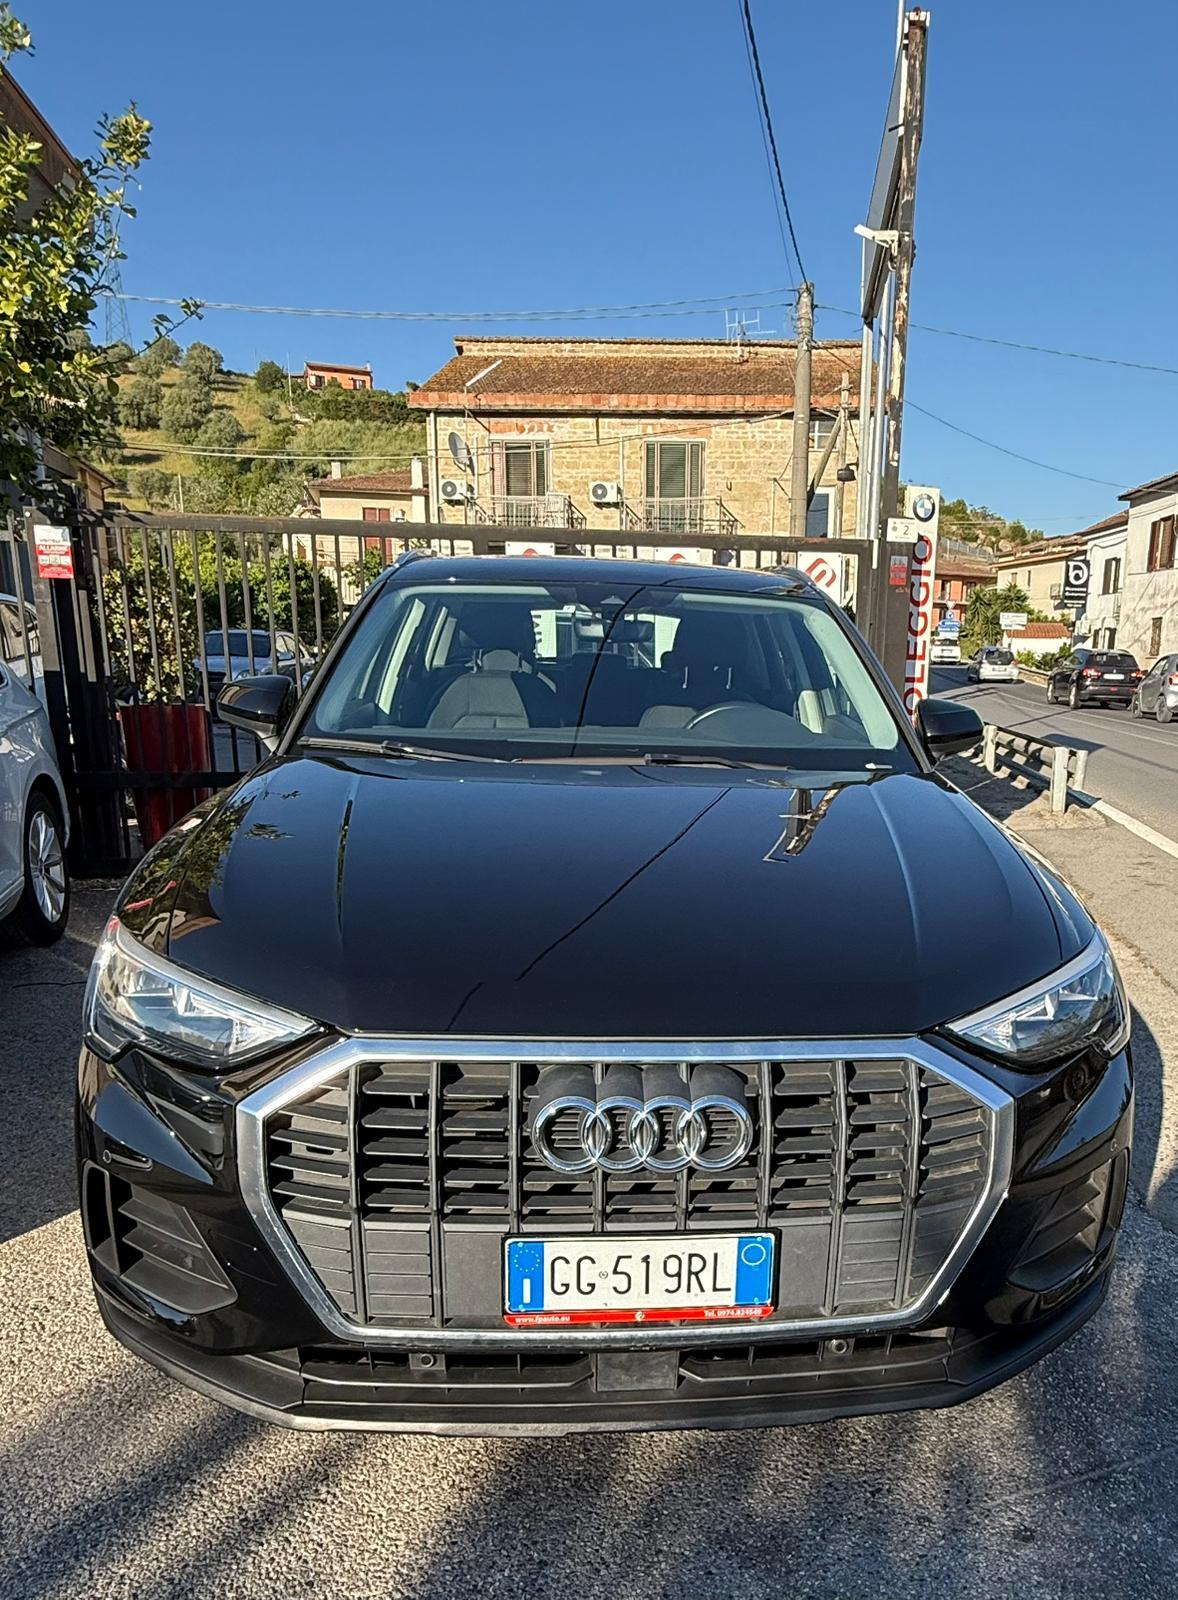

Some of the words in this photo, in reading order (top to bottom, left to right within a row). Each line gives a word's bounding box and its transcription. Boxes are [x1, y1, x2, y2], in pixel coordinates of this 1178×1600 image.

[903, 525, 910, 536] 2
[903, 535, 933, 729] OLEGGIO
[523, 1278, 531, 1303] I
[550, 1255, 596, 1295] GG
